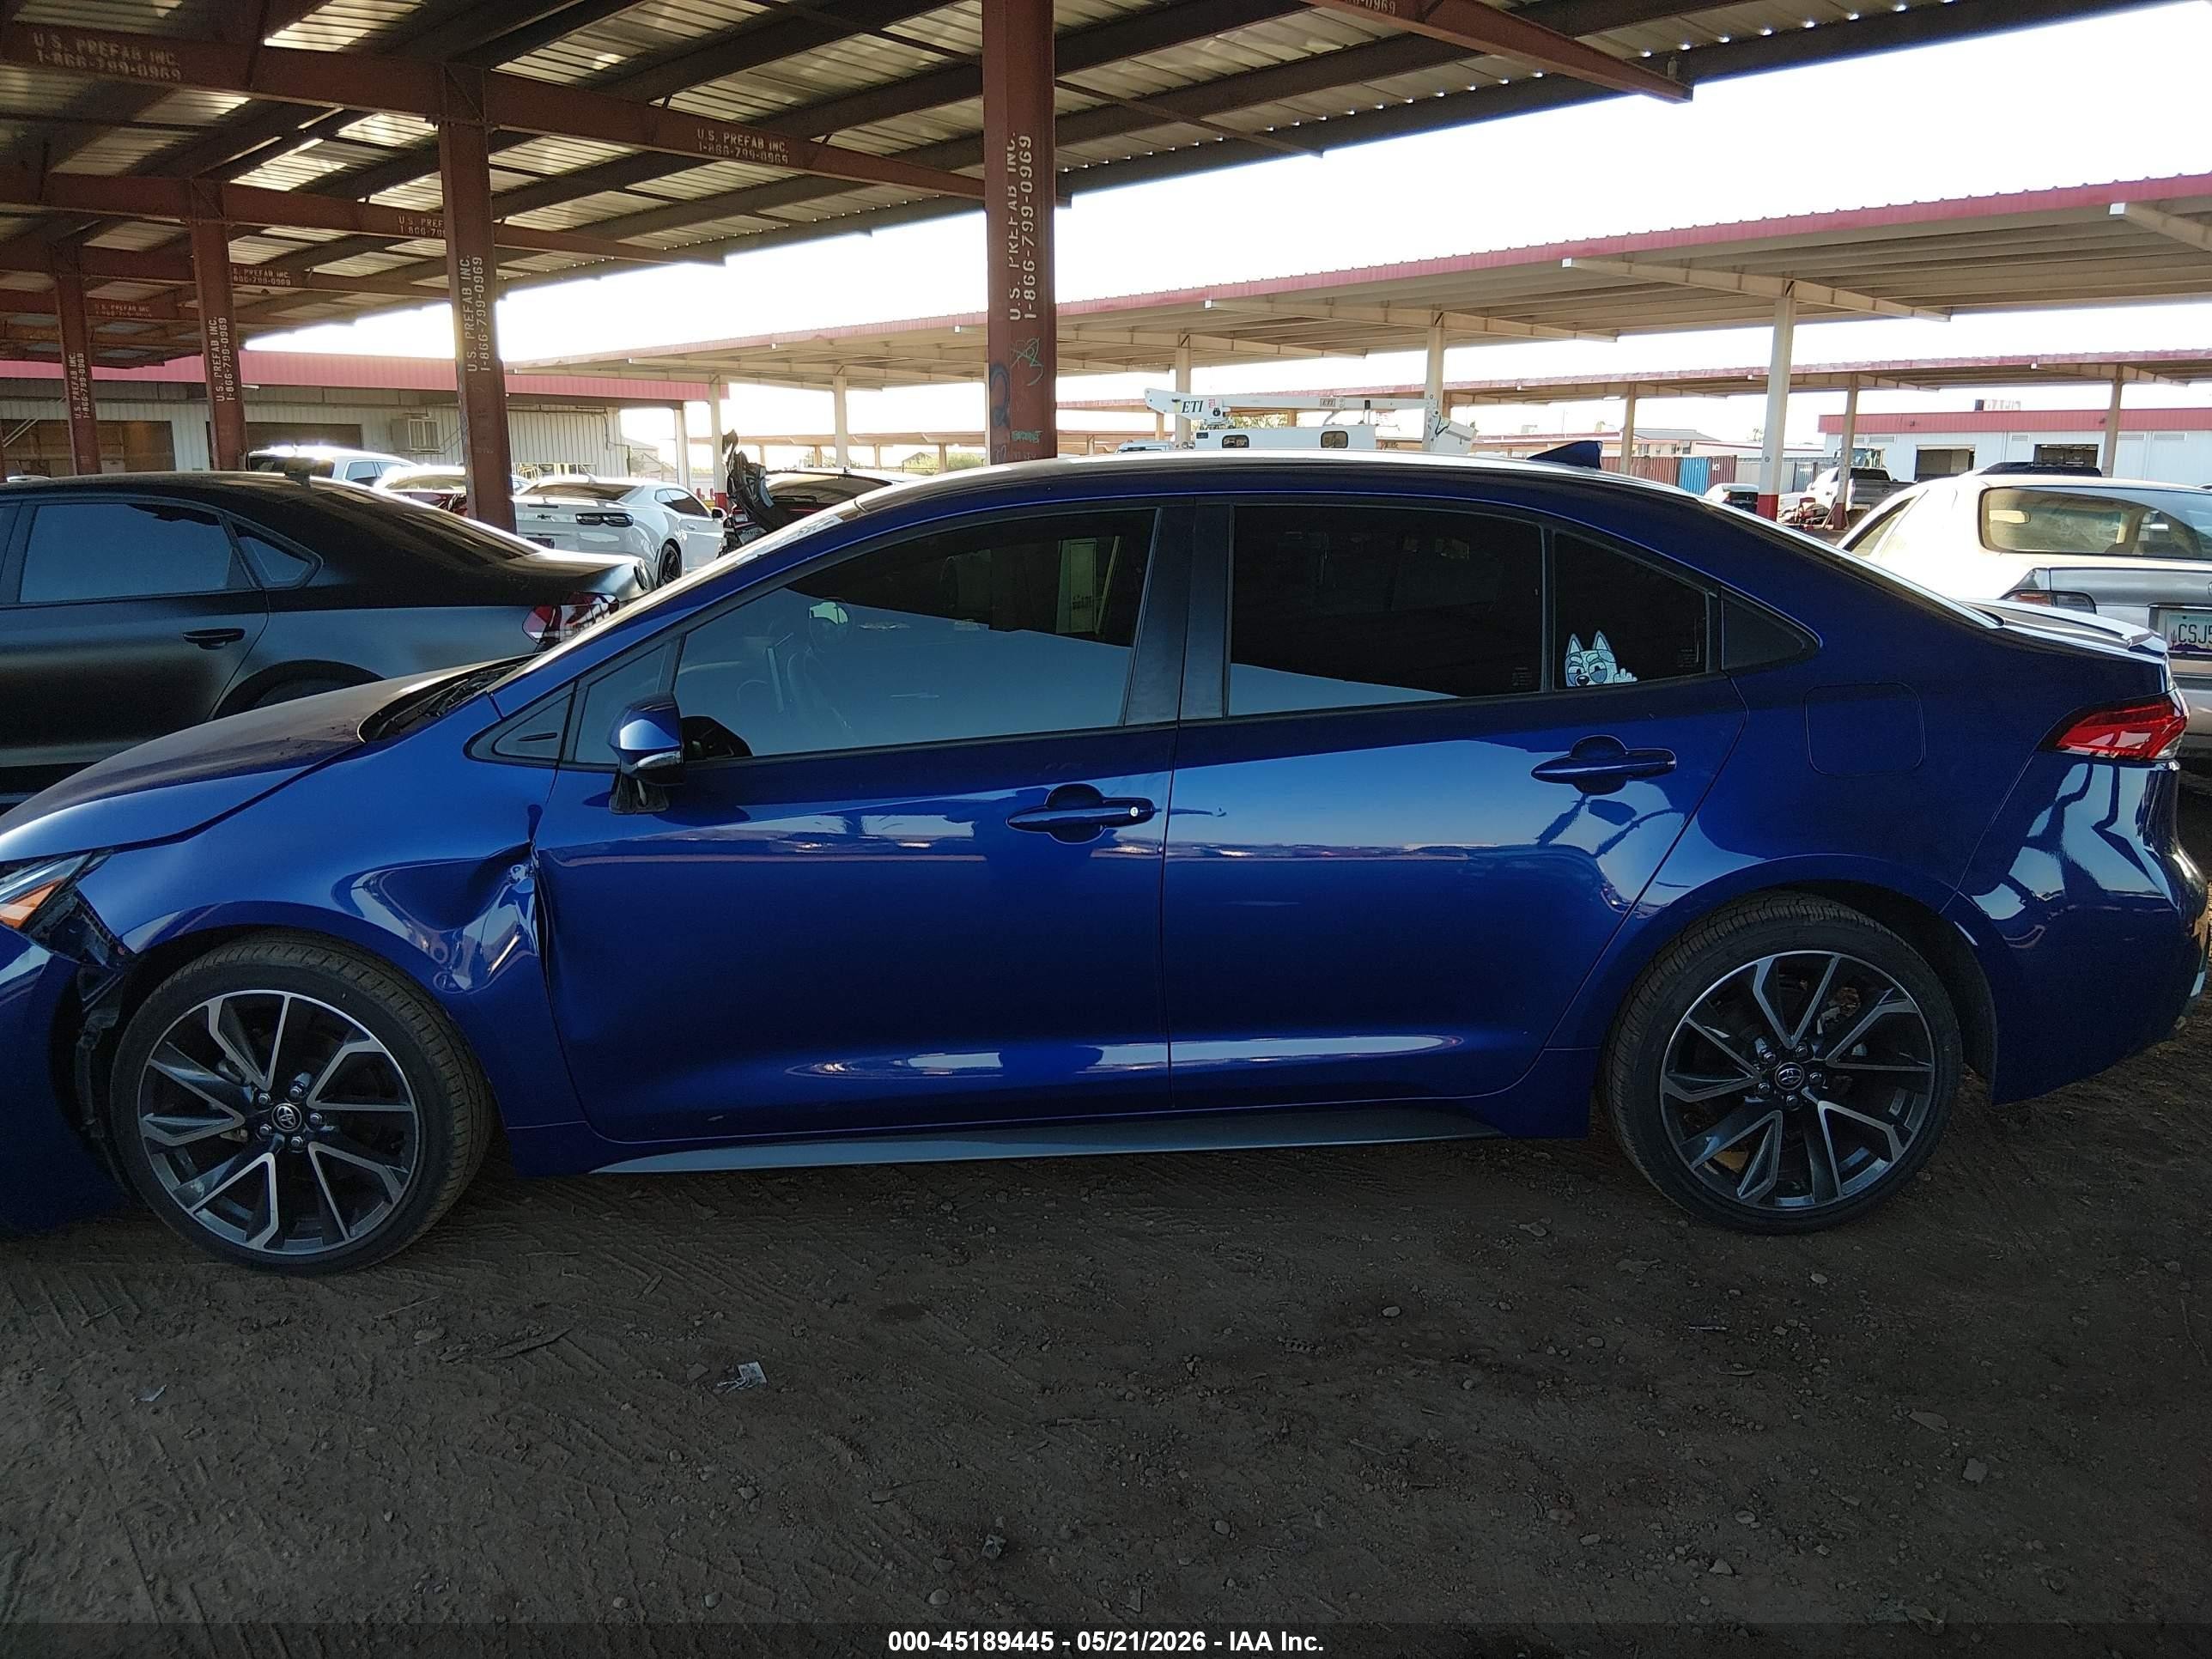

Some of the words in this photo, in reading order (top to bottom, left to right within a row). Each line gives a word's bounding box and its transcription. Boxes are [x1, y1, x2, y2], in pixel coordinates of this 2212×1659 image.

[76, 39, 142, 61] PREFAB
[697, 128, 718, 143] U.S.
[723, 132, 764, 149] PREFAB
[769, 140, 789, 153] INC.
[699, 142, 788, 164] 1-866-799-0969
[1006, 131, 1017, 173] INC.
[421, 218, 444, 228] PREF
[1007, 185, 1019, 268] PREFAB
[1018, 135, 1037, 319] 1-866-799-0969
[459, 254, 471, 281] INC.
[461, 287, 475, 339] PREFAB
[472, 257, 491, 372] 1-866-799-0969
[1009, 281, 1021, 320] U.S.
[209, 316, 218, 336] INC.
[210, 340, 222, 378] PREFAB
[218, 317, 236, 401] 1-866-799-0969
[466, 347, 478, 372] U.S.
[70, 370, 81, 400] PREFAB
[216, 383, 226, 402] U.S.
[1182, 400, 1204, 413] ETI
